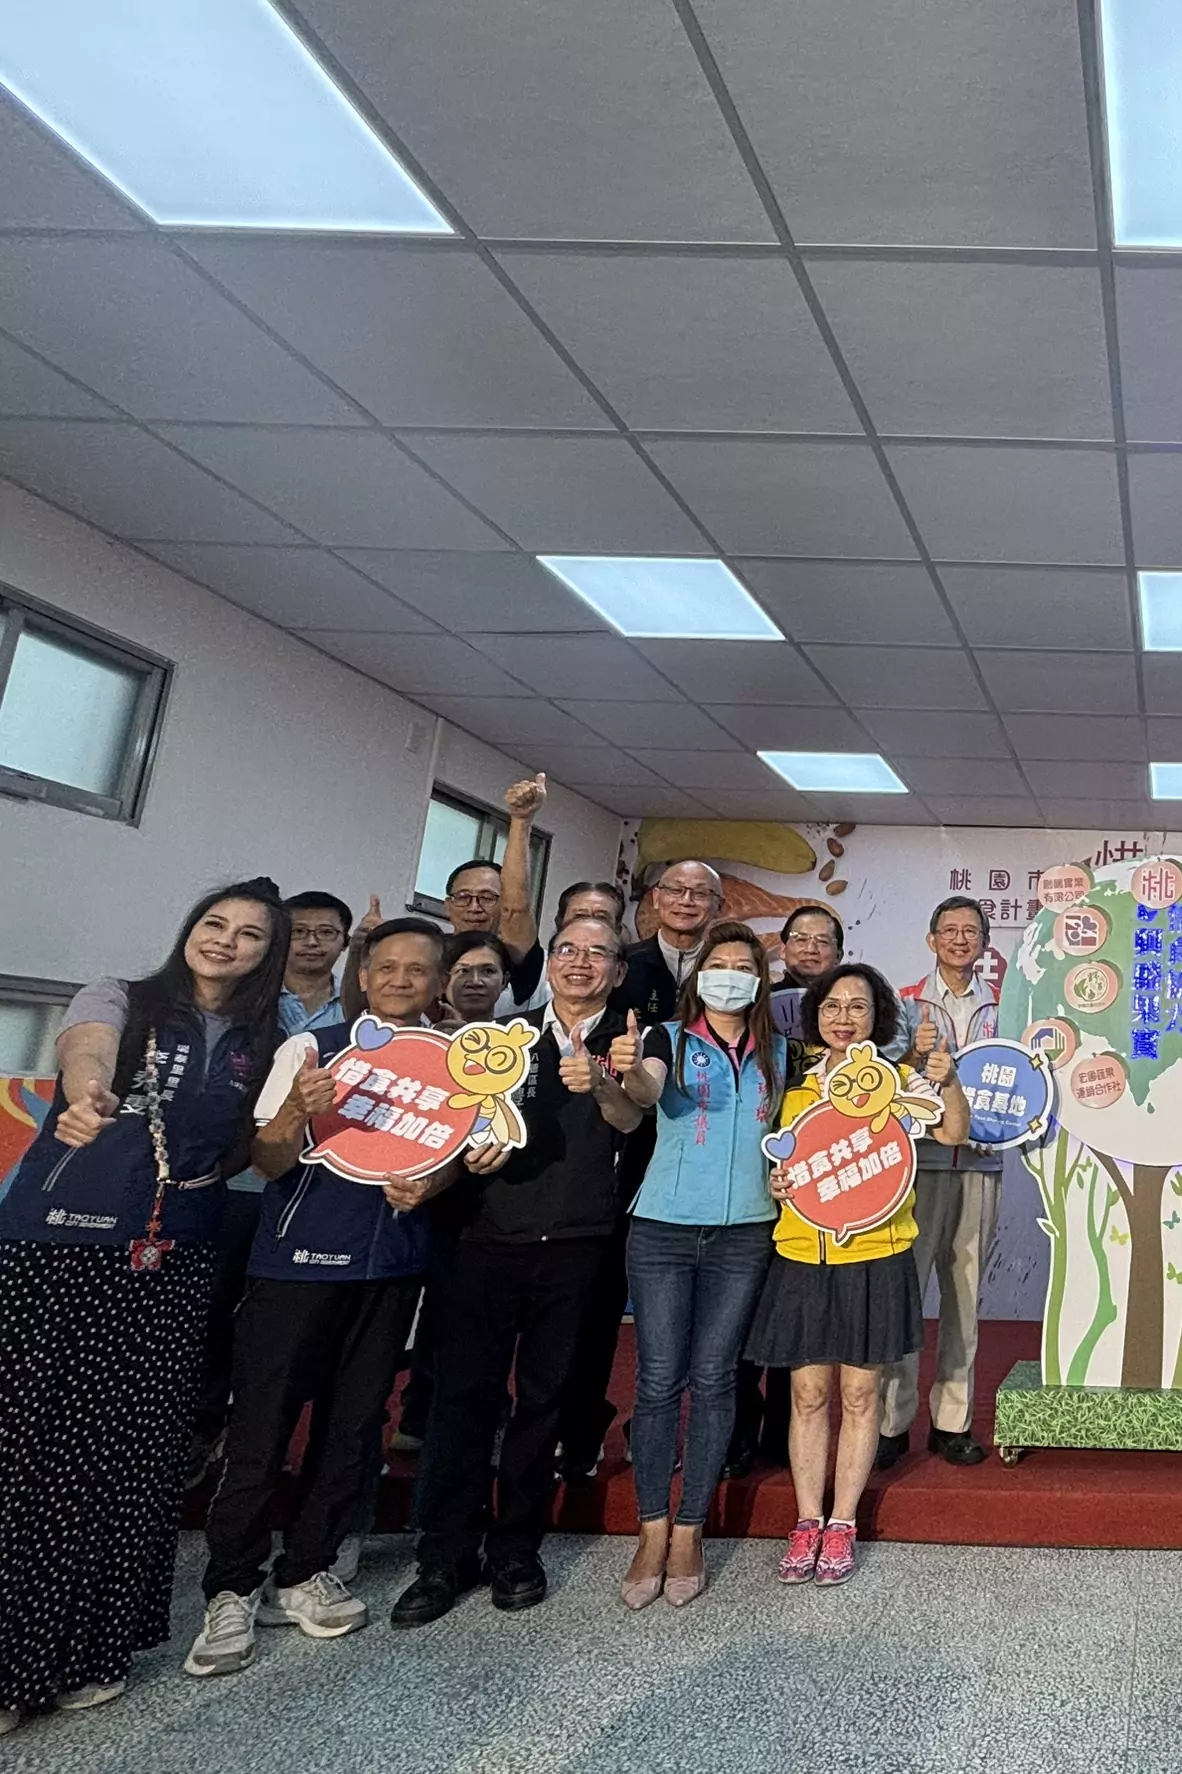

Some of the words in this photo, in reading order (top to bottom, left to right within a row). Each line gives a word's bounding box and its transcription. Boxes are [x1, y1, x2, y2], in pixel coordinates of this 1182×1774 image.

[334, 1057, 450, 1111] 惜食共享
[981, 1062, 1017, 1088] 桃園
[338, 1094, 455, 1150] 幸福加倍
[787, 1126, 873, 1190] 惜食共享
[816, 1141, 903, 1204] 幸福加倍
[68, 1213, 118, 1224] TAOYUAN
[309, 1252, 351, 1261] TAOYUAN
